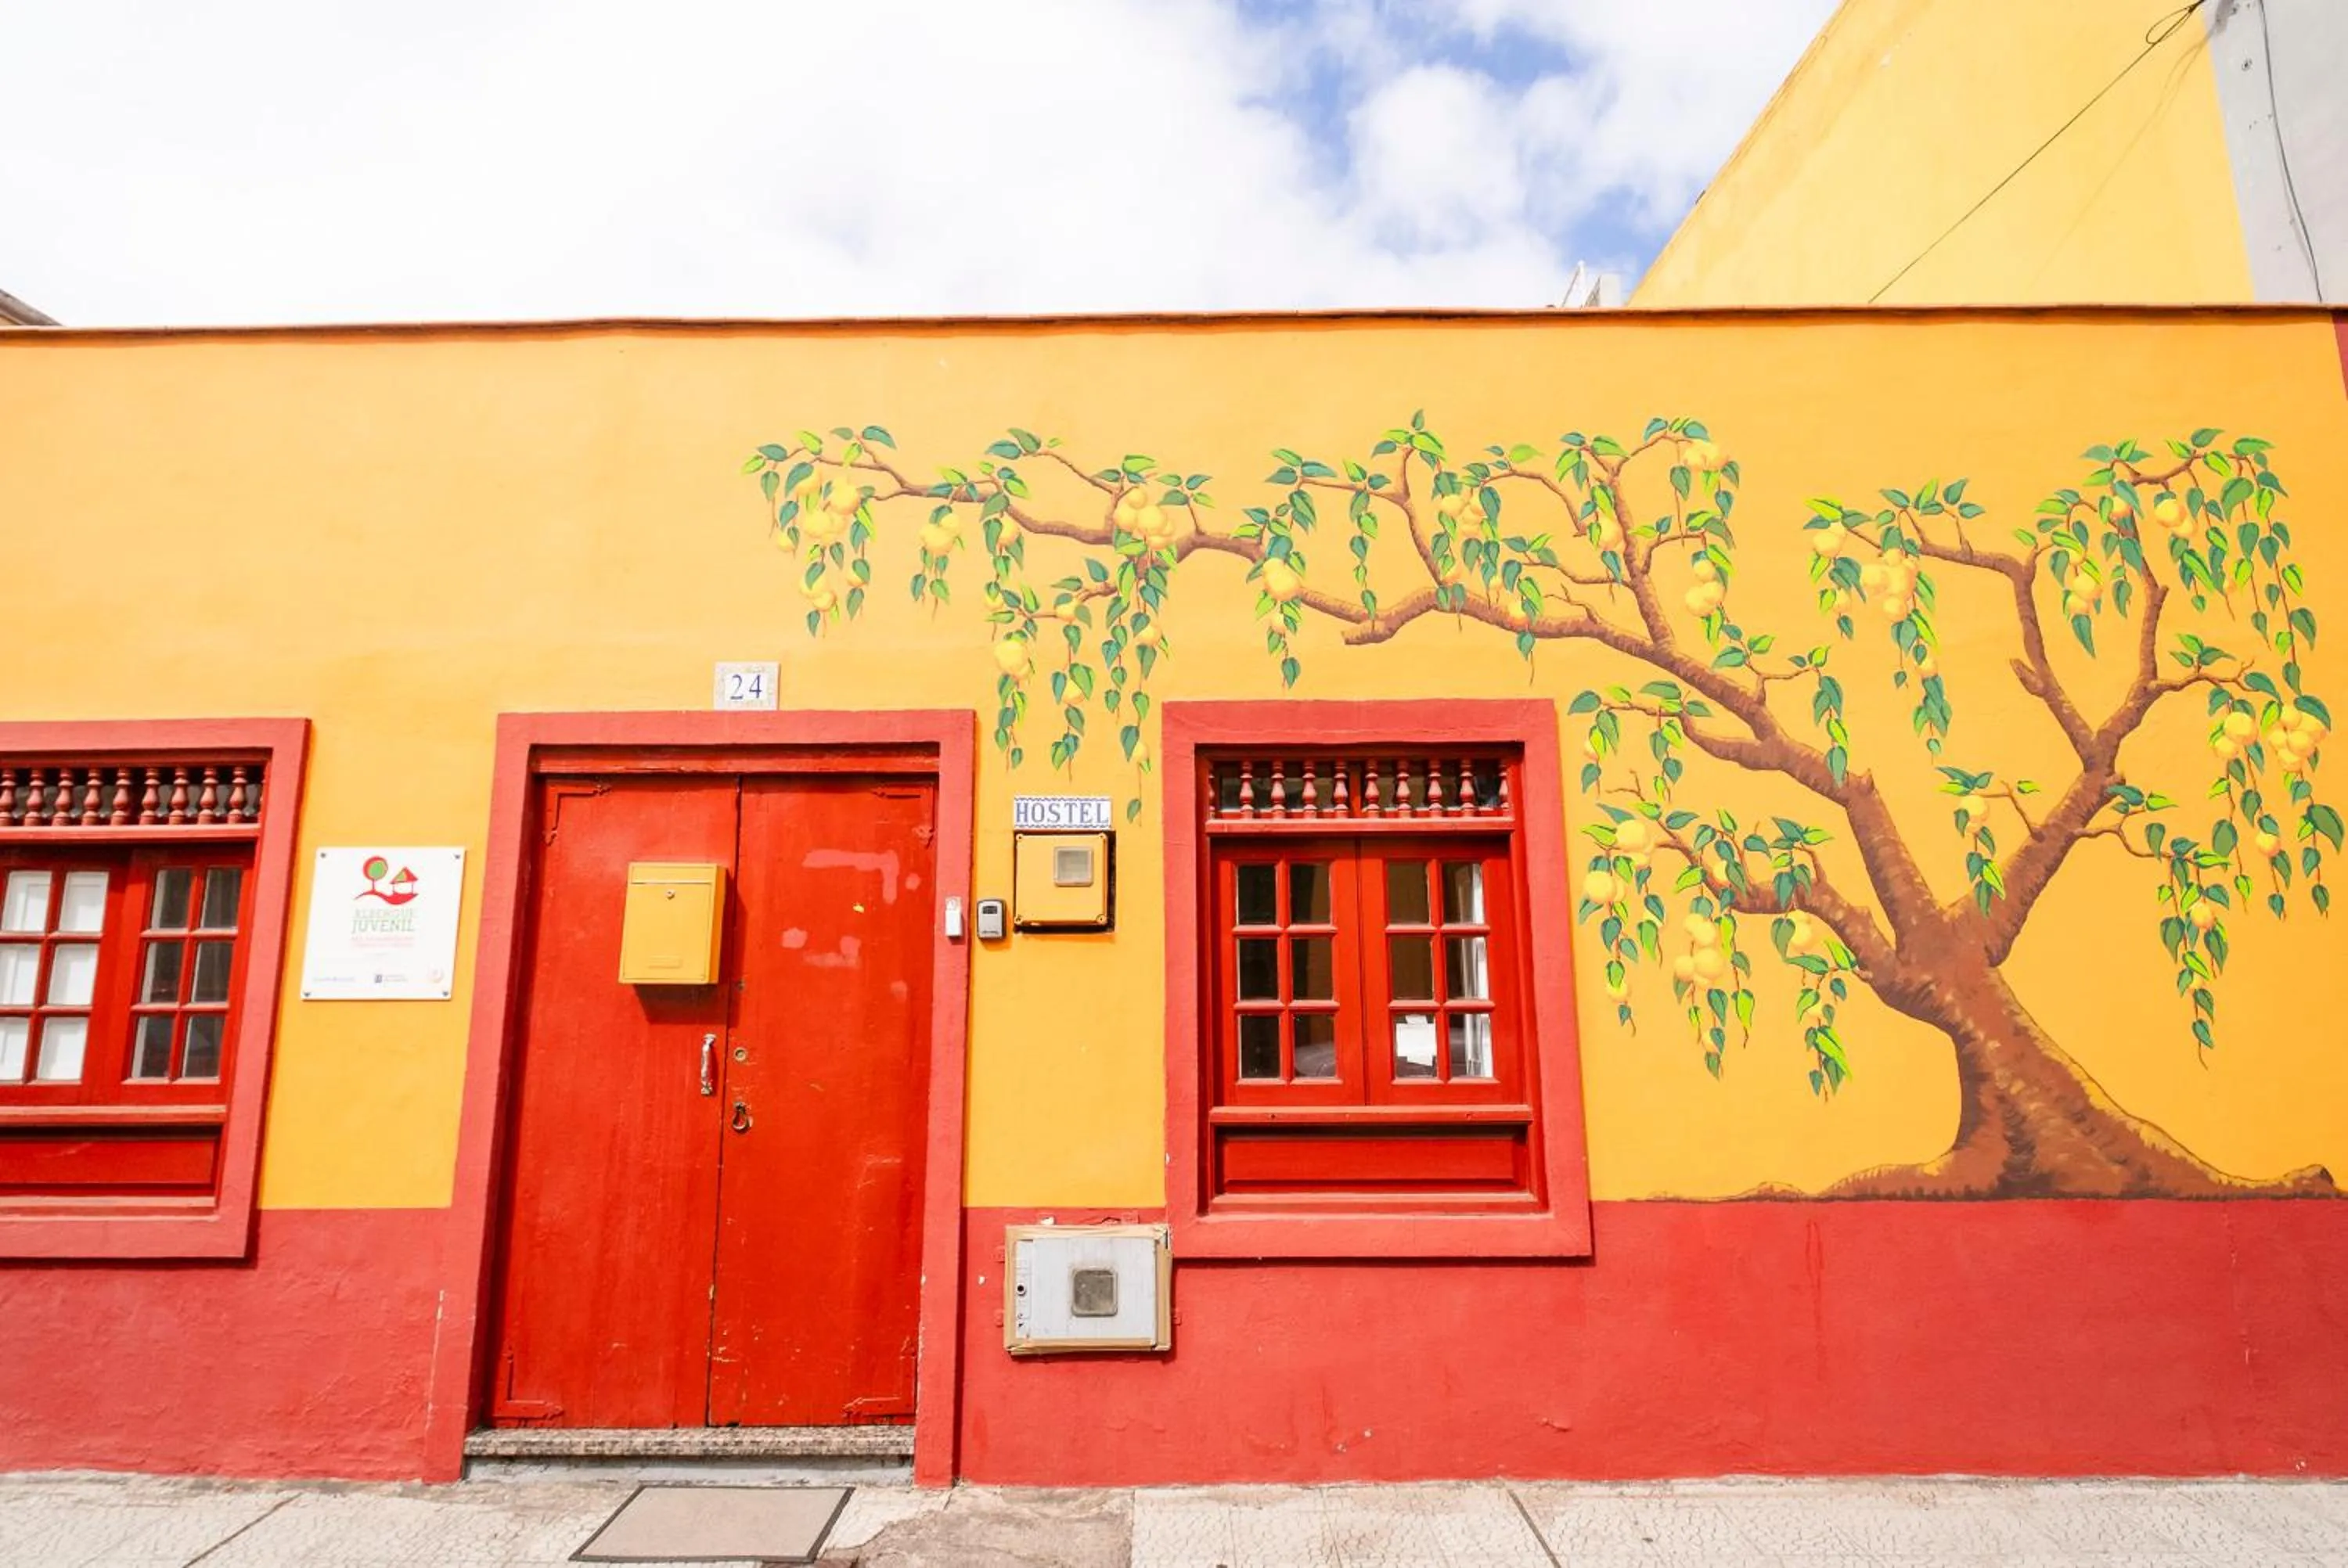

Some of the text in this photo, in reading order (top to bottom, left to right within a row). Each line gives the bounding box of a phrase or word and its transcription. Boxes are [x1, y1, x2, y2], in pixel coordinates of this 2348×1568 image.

[729, 673, 762, 699] 24
[1016, 801, 1109, 824] HOSTEL
[351, 919, 415, 933] JUVENIL
